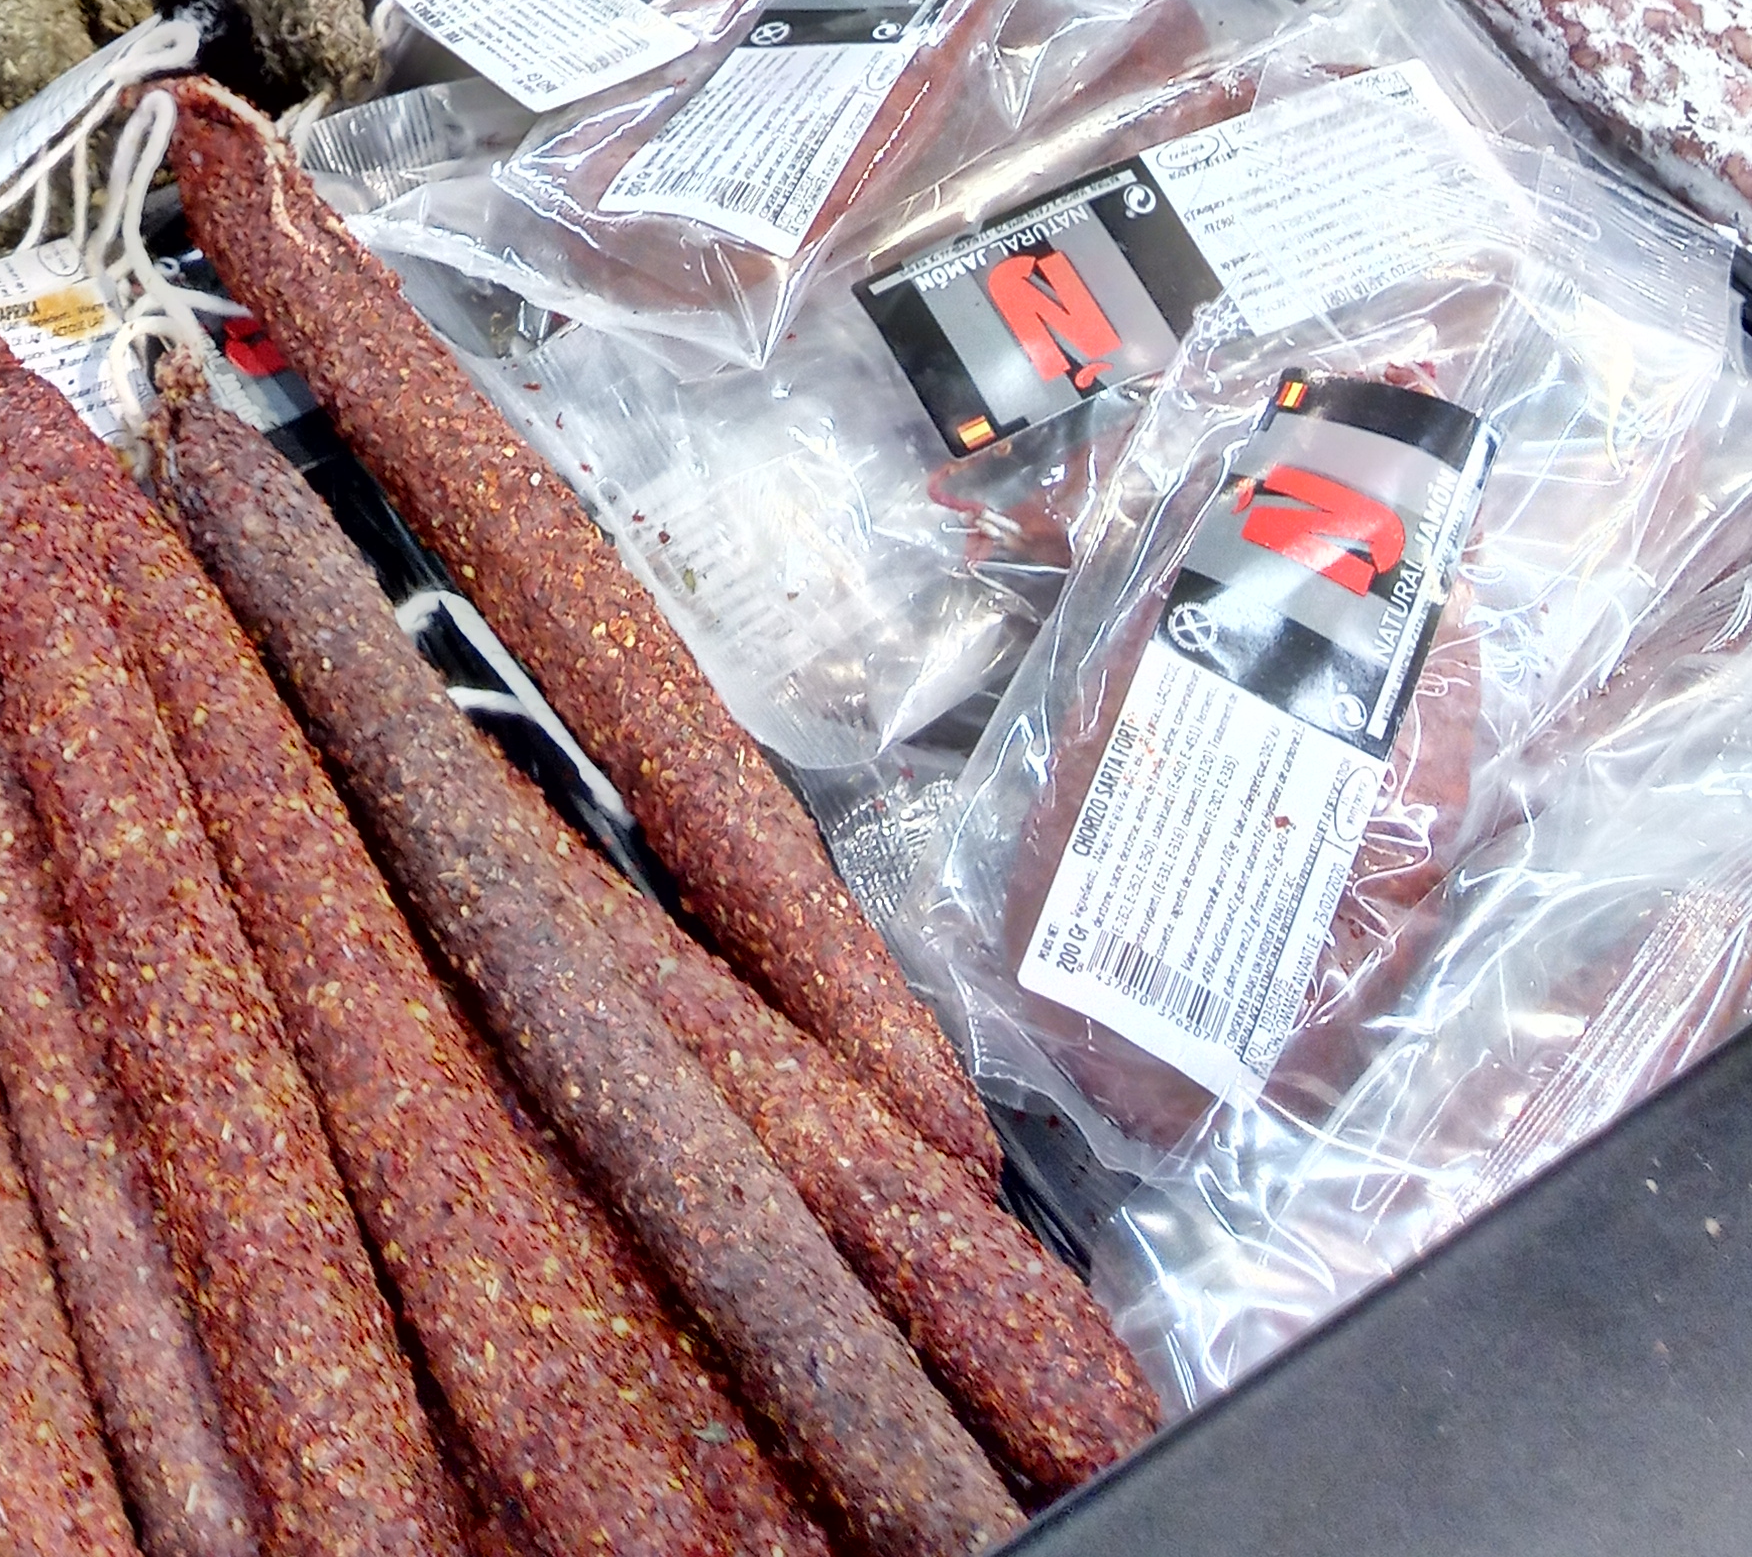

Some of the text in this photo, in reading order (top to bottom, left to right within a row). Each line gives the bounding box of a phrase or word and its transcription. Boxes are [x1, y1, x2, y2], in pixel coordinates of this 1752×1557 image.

[913, 202, 1090, 298] NATURAL JAMÓN
[1366, 555, 1429, 664] NATURAL
[1070, 796, 1110, 858] CHORIZO
[1093, 754, 1127, 799] SARTA
[1309, 861, 1348, 928] 25/02/2020
[1054, 940, 1082, 973] 200
